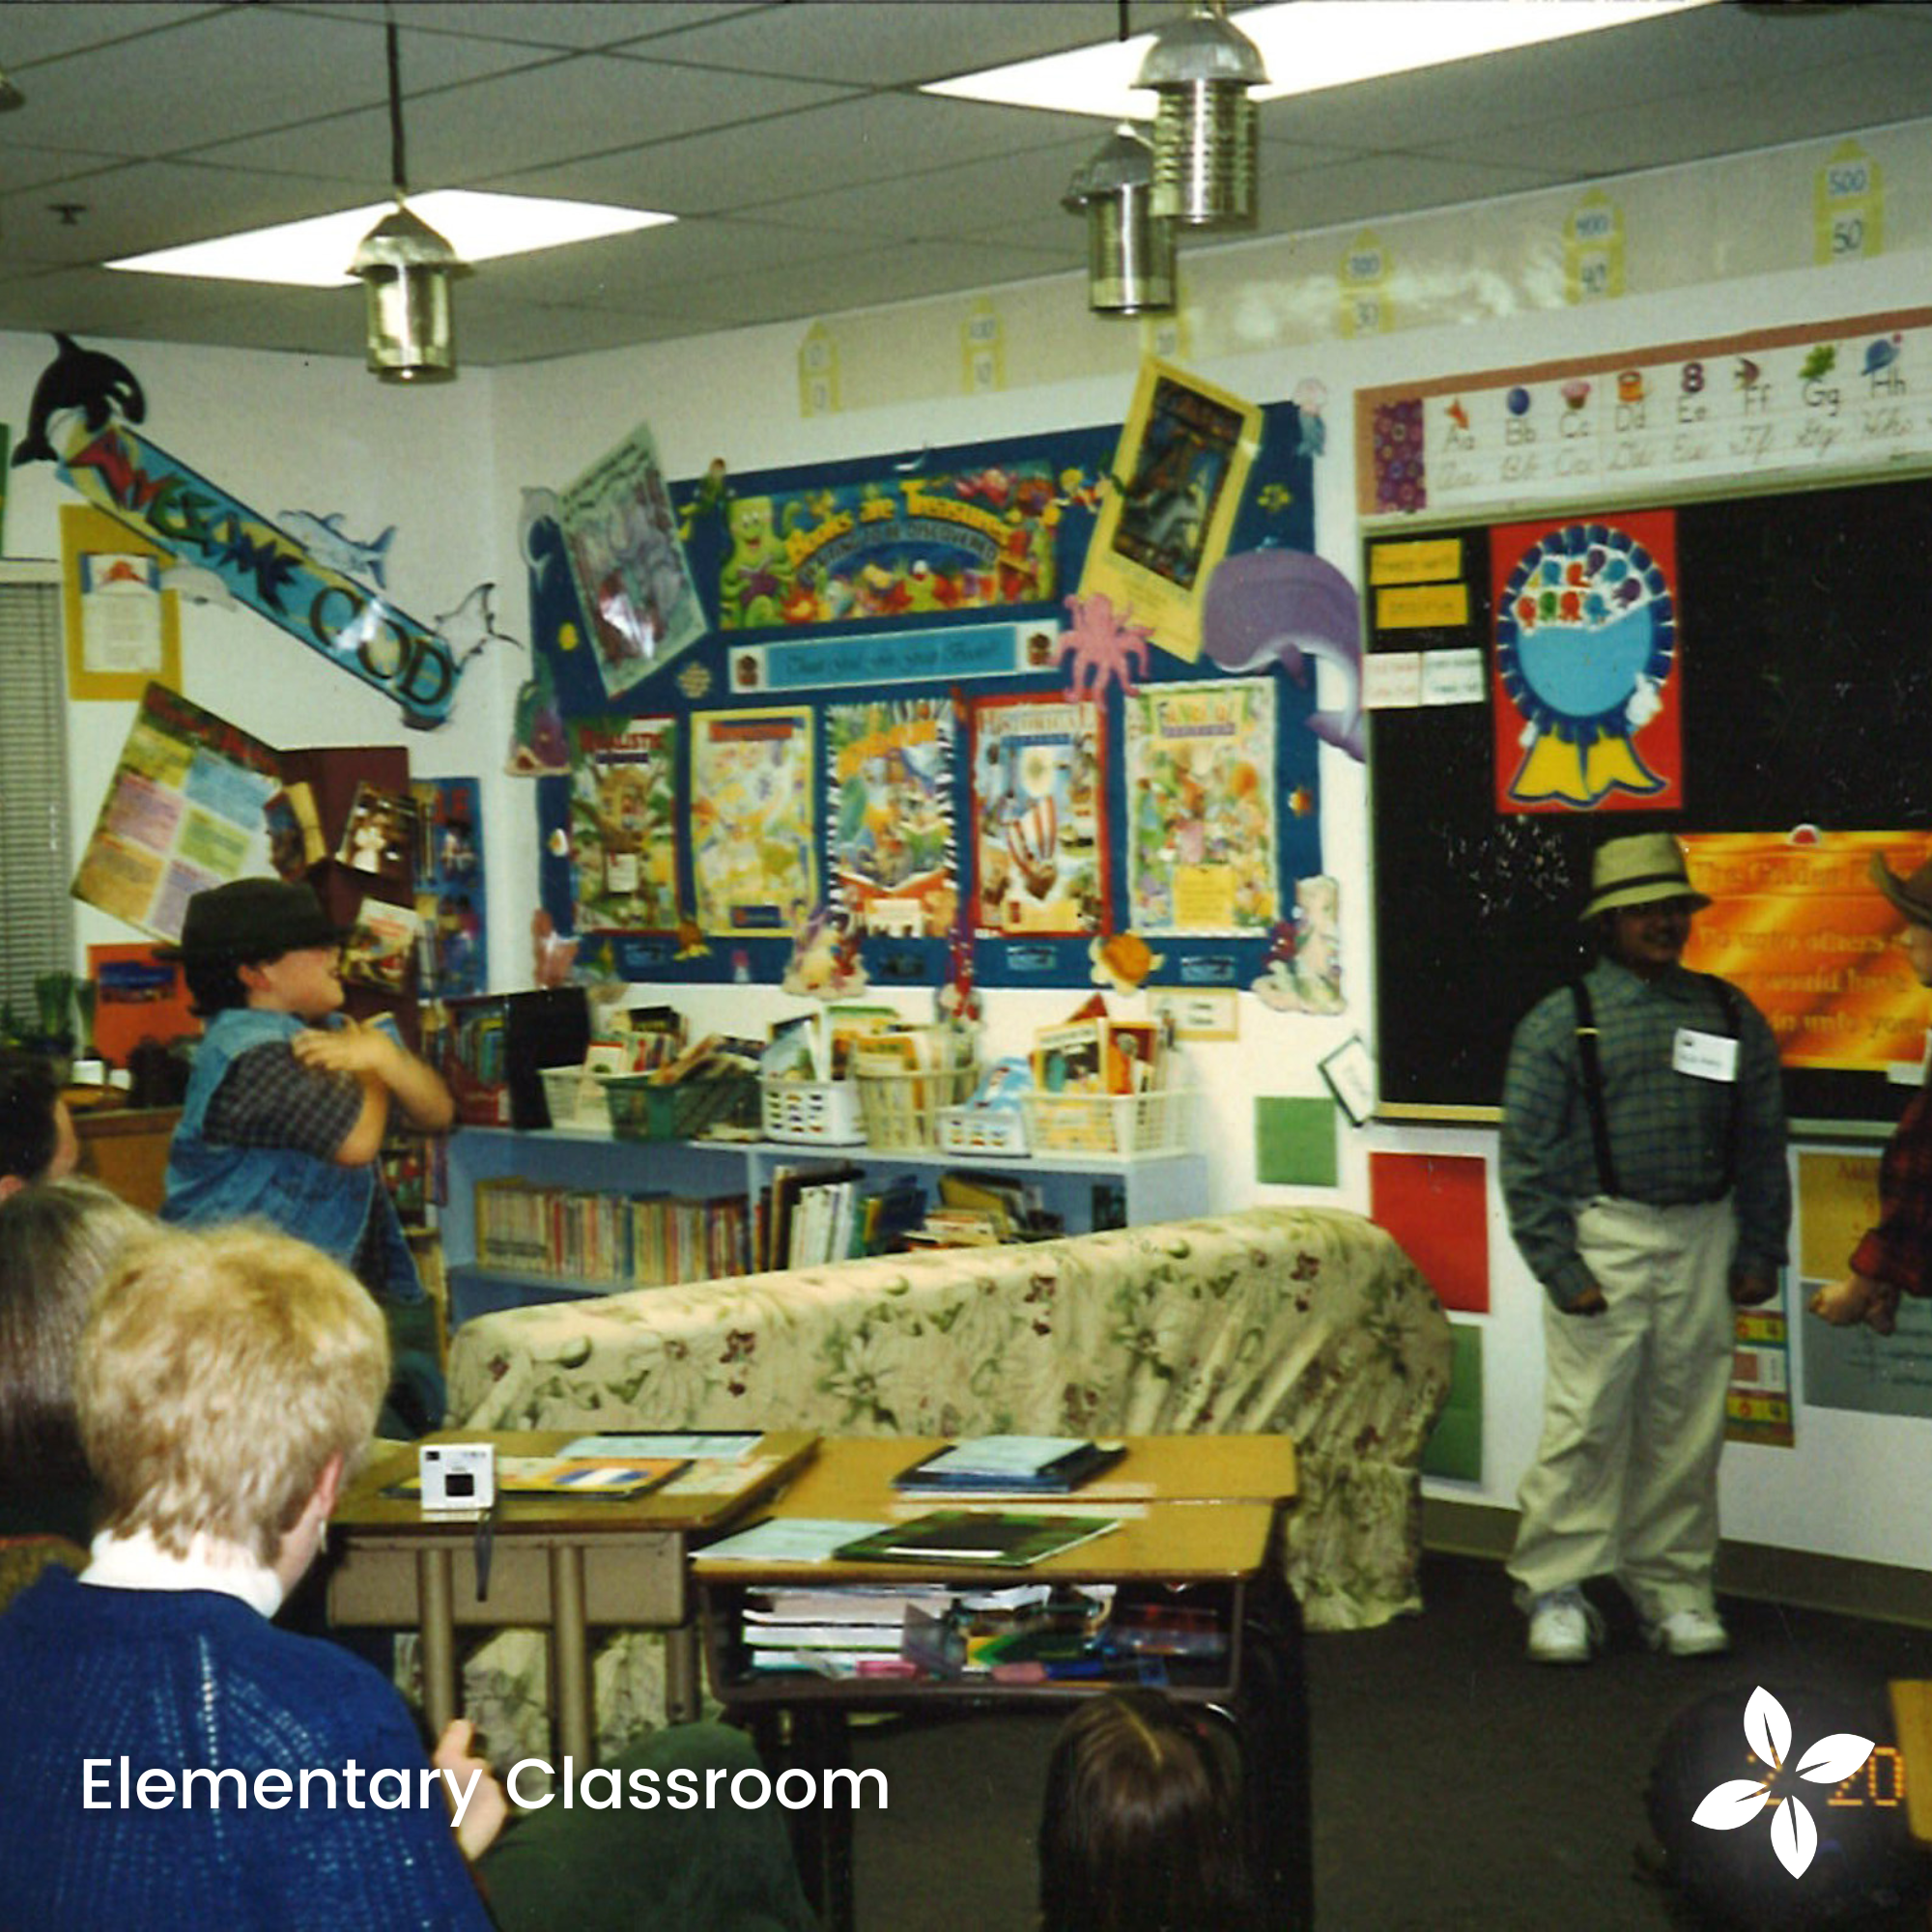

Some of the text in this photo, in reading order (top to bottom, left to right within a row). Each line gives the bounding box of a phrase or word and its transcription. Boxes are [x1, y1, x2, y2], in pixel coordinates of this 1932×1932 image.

[1830, 169, 1865, 194] 500
[1833, 218, 1862, 253] 50
[1444, 367, 1907, 452] Aa Bb Cc Dd Ee Ff Gg Hh
[1805, 931, 1885, 952] others
[1770, 966, 1840, 993] would
